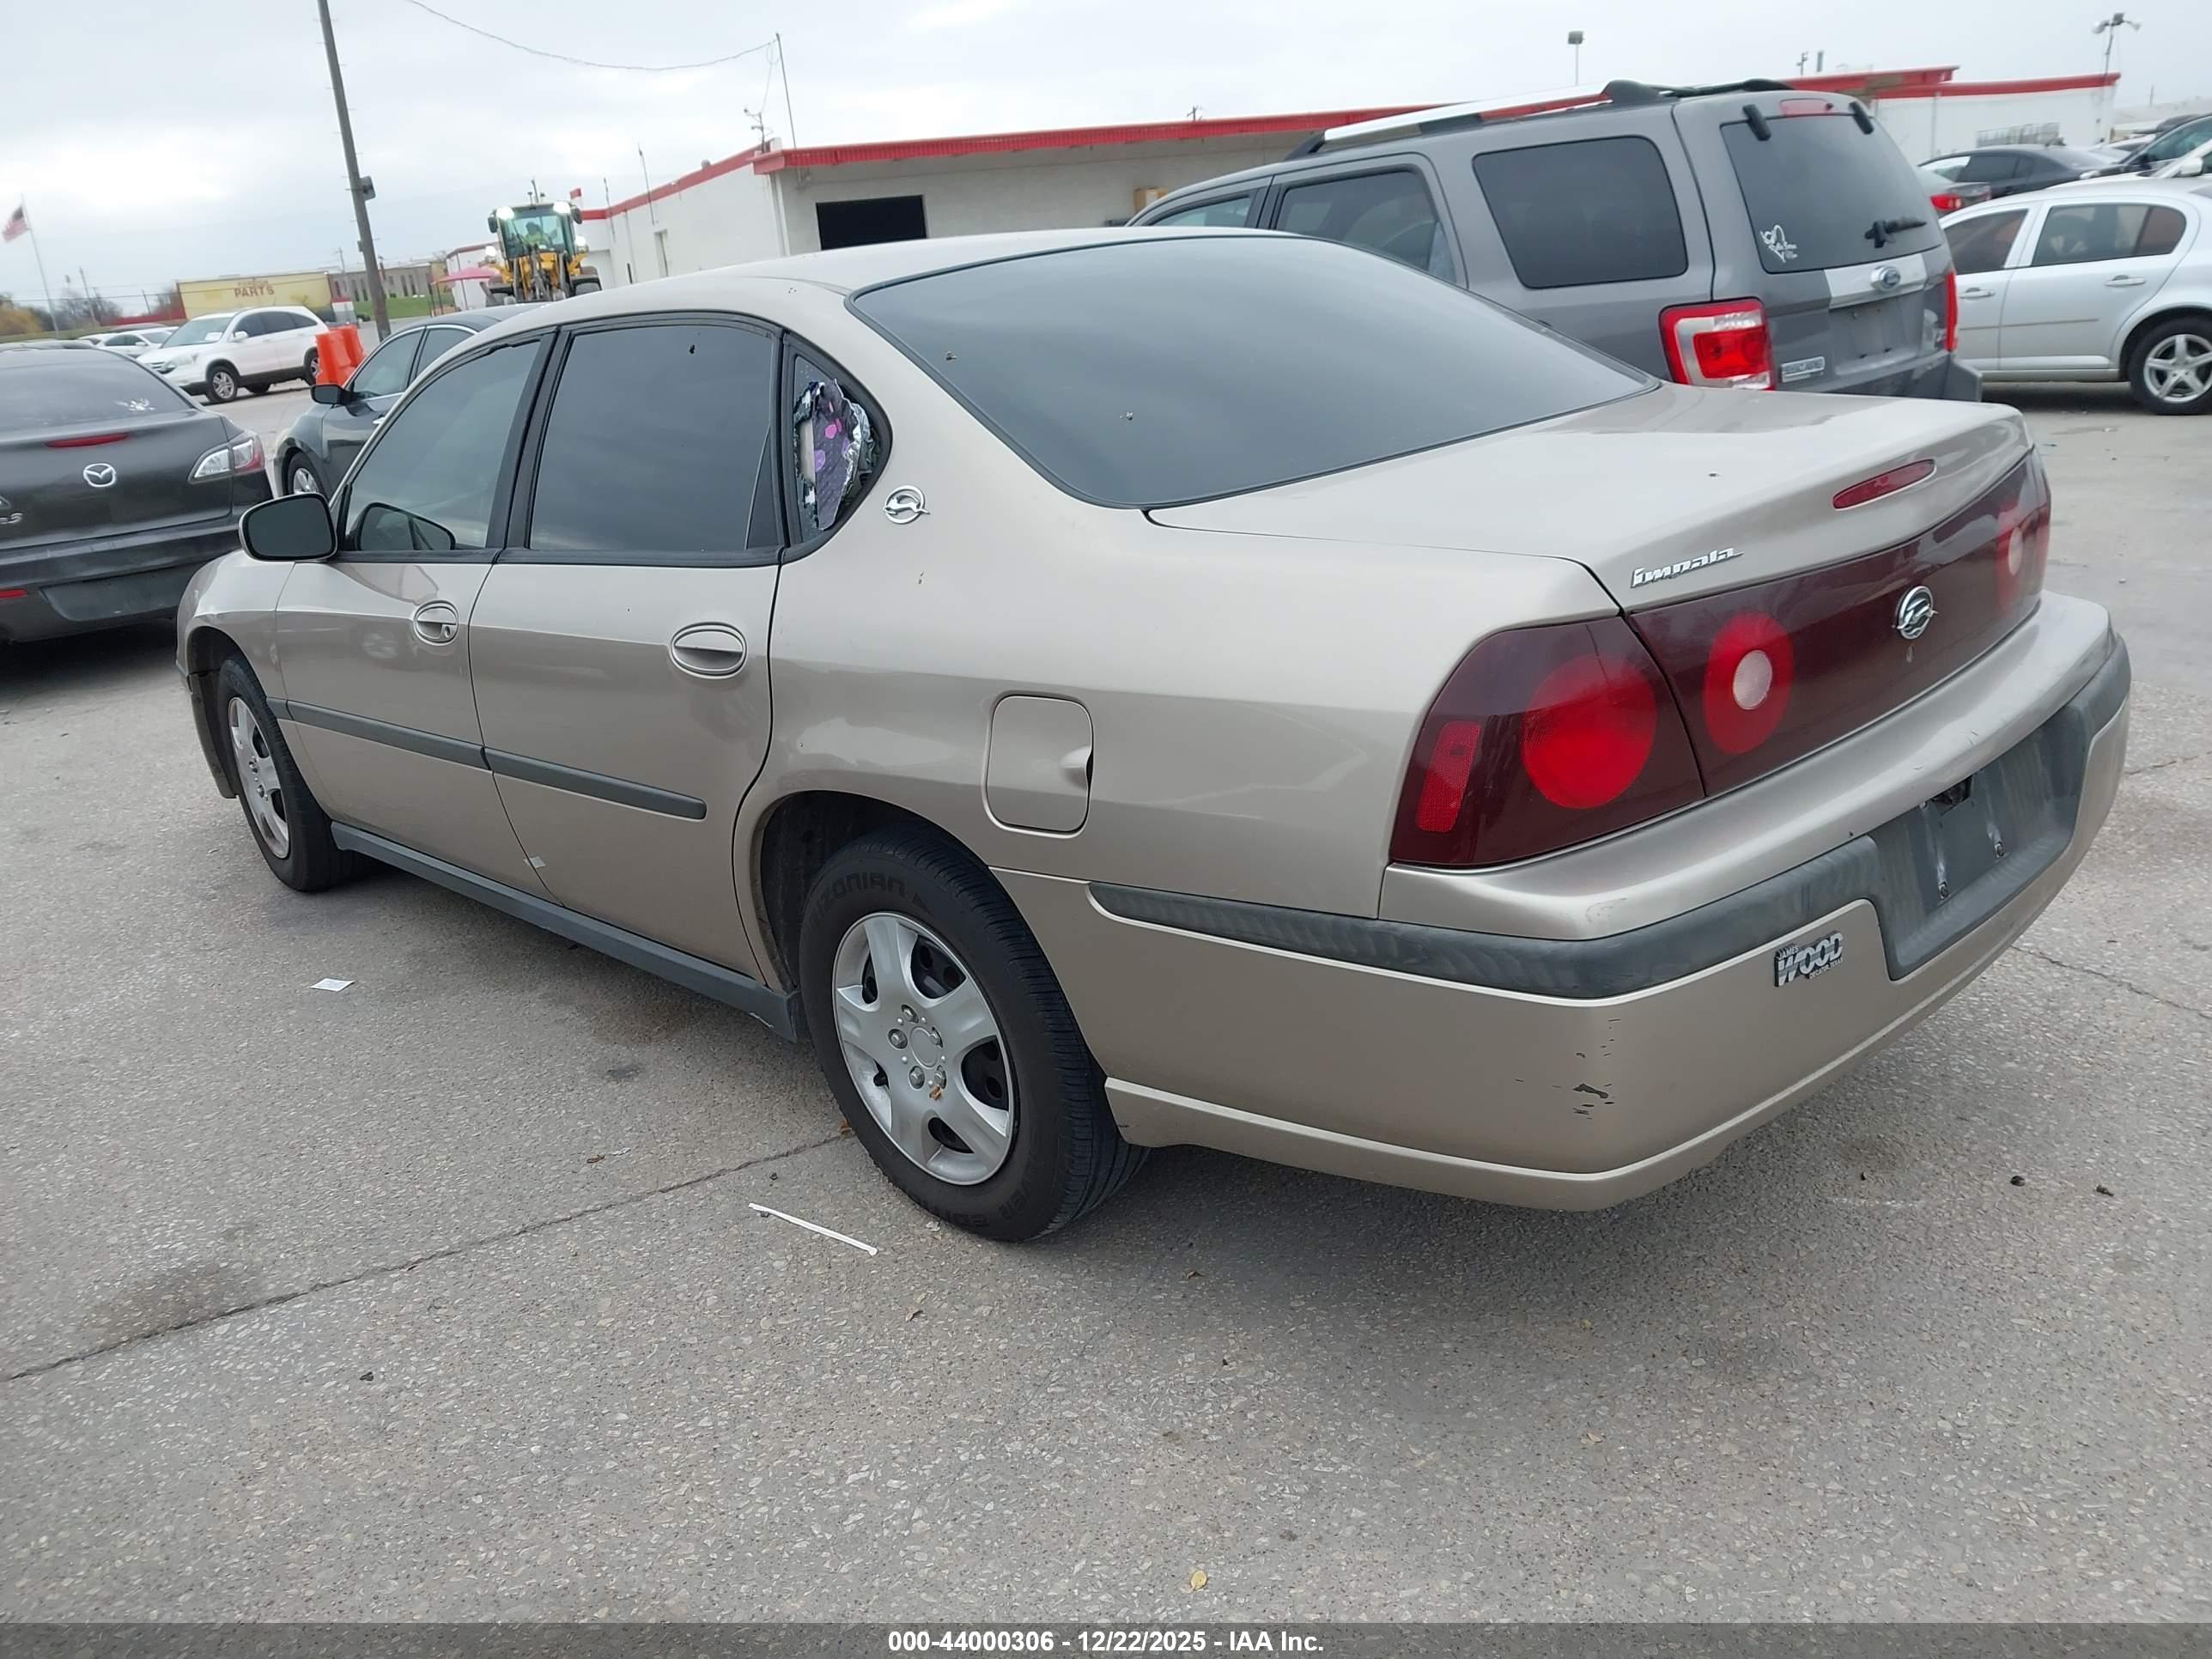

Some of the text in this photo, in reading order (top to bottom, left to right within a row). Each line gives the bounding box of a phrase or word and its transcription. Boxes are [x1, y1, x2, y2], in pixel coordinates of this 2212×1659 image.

[234, 286, 275, 297] PARTS
[1630, 546, 1745, 588] Impala
[1778, 945, 1799, 960] JAMES
[1778, 933, 1843, 987] WOOD
